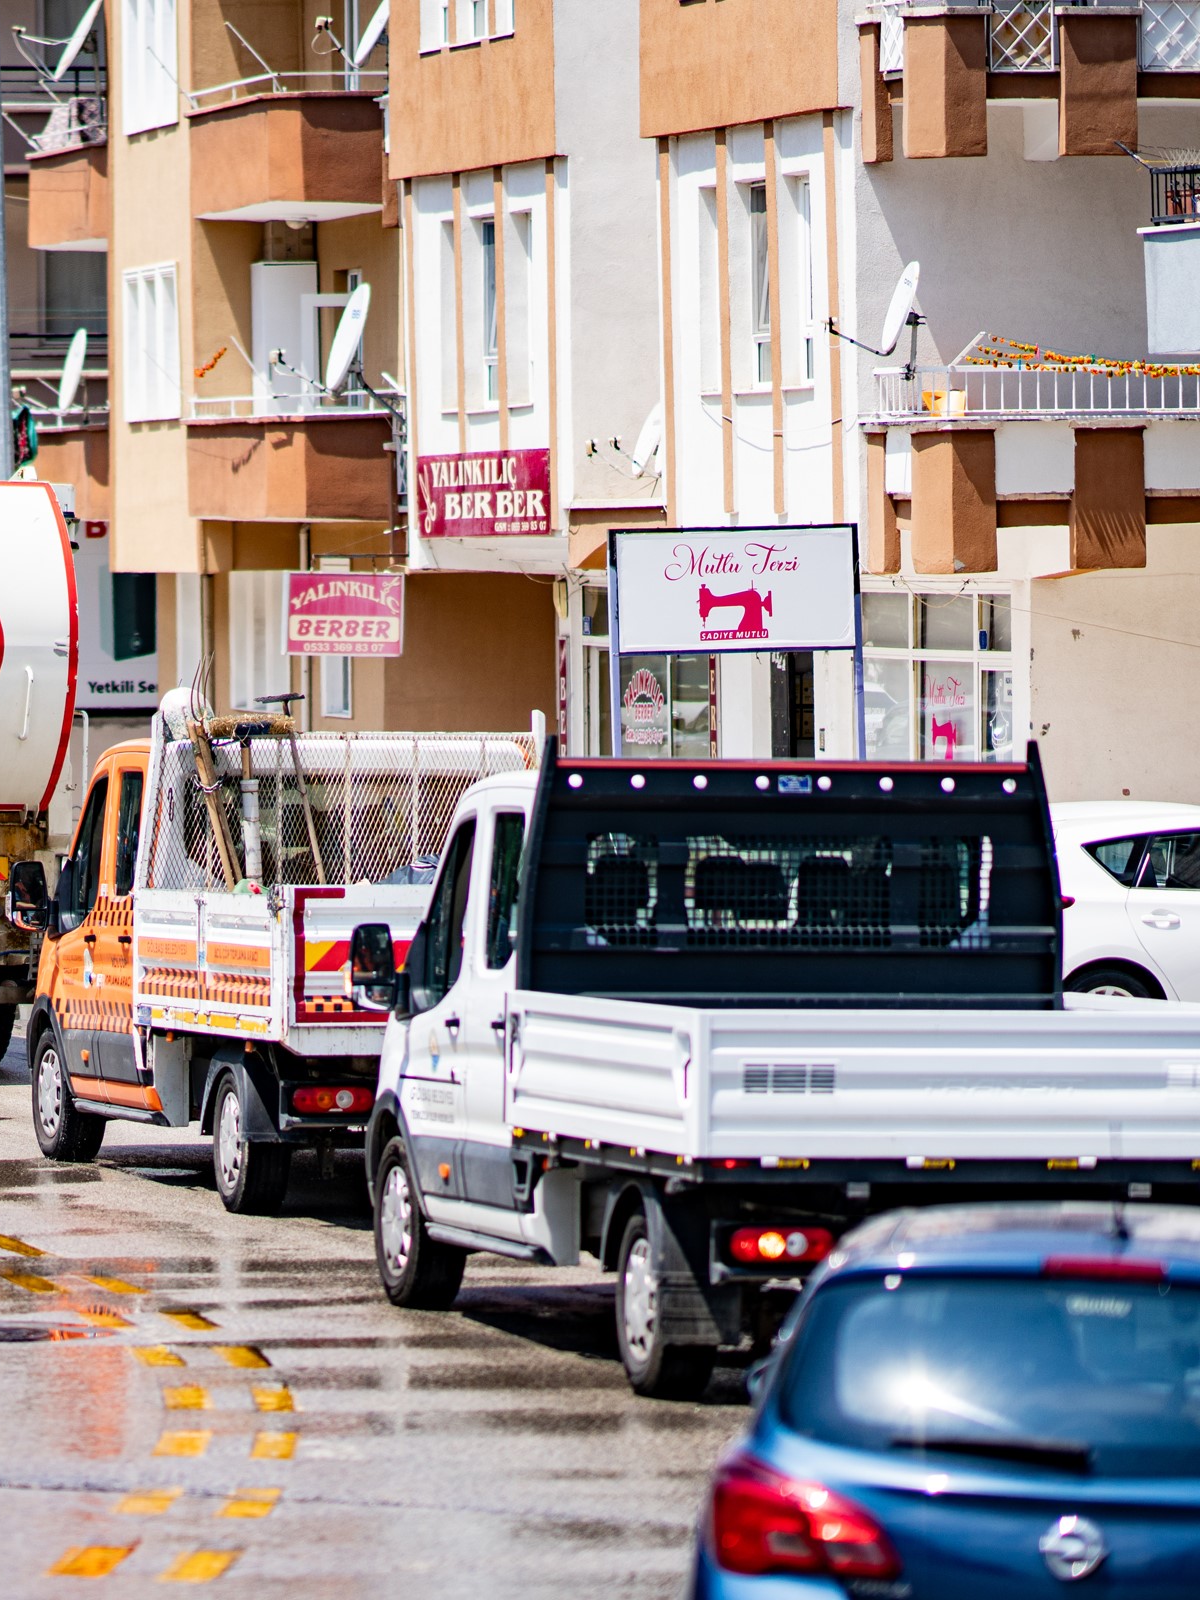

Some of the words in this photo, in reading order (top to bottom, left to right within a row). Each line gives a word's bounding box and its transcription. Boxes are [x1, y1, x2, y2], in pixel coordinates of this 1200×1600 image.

[430, 457, 517, 490] YALINKILIÇ
[664, 543, 743, 581] Mutlu
[744, 542, 801, 576] Terzi
[290, 580, 400, 615] YALINKILIÇ
[297, 619, 391, 639] BERBER
[701, 631, 734, 640] SADİYE
[736, 629, 768, 639] MUTLU
[88, 681, 133, 694] Yetkili
